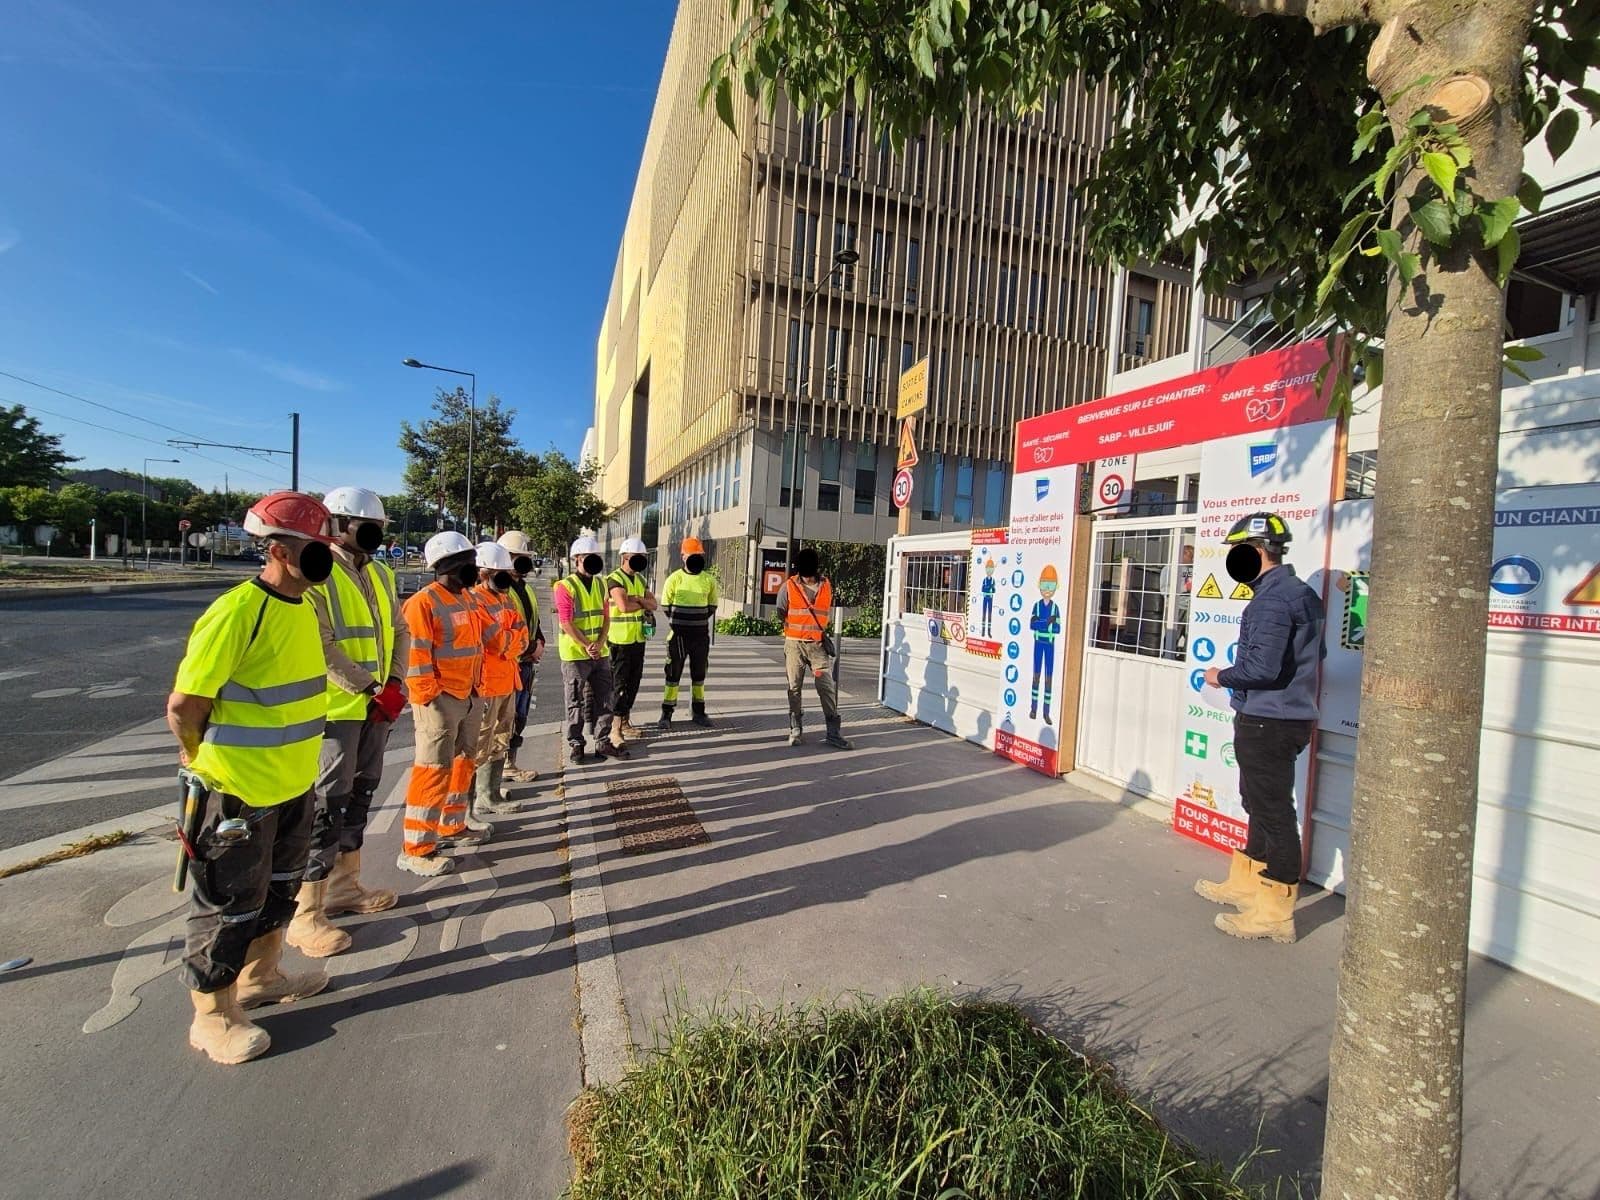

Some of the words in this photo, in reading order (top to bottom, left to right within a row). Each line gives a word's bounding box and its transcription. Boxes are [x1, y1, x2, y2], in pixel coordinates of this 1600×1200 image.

[1221, 385, 1255, 402] SANTÉ
[1262, 370, 1319, 393] SÉCURITÉ
[1077, 406, 1122, 425] BIENVENUE
[1122, 401, 1141, 414] SUR
[1141, 396, 1154, 409] LE
[1098, 431, 1122, 445] SABP
[1127, 420, 1175, 439] VILLEJUIF
[1101, 456, 1128, 468] ZONE
[1252, 453, 1276, 466] SABP
[896, 481, 908, 498] 30
[1104, 482, 1120, 497] 30
[1202, 499, 1228, 510] Vous
[1231, 496, 1267, 507] entrez
[1270, 492, 1301, 505] dans
[1012, 515, 1028, 523] Avant
[1030, 512, 1049, 522] d'aller
[1050, 512, 1064, 523] plus
[1201, 513, 1221, 524] une
[1223, 512, 1247, 523] zon
[1024, 525, 1031, 535] je
[1032, 524, 1060, 534] m'assure
[1200, 528, 1211, 538] et
[1010, 535, 1028, 545] d'être
[767, 573, 782, 592] P
[1013, 739, 1043, 757] ACTEURS
[1179, 804, 1209, 824] TOUS
[1178, 817, 1194, 832] DE
[1195, 824, 1211, 839] LA
